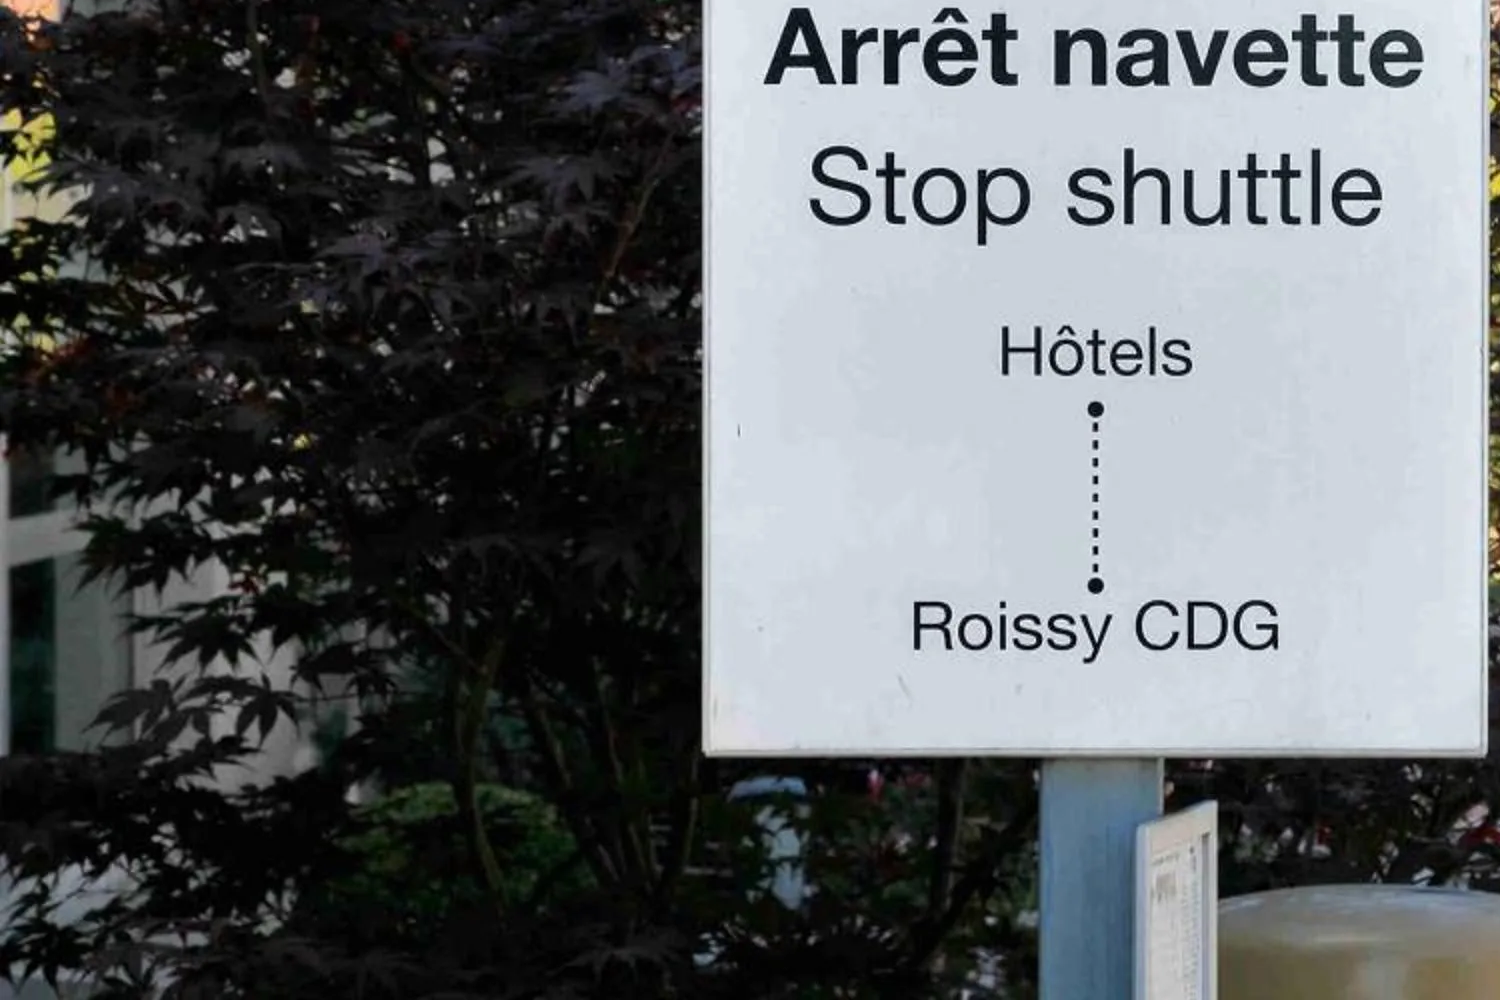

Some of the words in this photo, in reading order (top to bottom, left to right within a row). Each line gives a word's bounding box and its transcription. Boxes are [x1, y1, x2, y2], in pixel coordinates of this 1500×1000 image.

[763, 6, 1019, 86] Arrêt
[1053, 13, 1424, 87] navette
[808, 145, 1031, 246] Stop
[1066, 147, 1383, 226] shuttle
[1001, 325, 1193, 377] Hôtels
[912, 601, 1112, 663] Roissy
[1134, 599, 1280, 652] CDG
